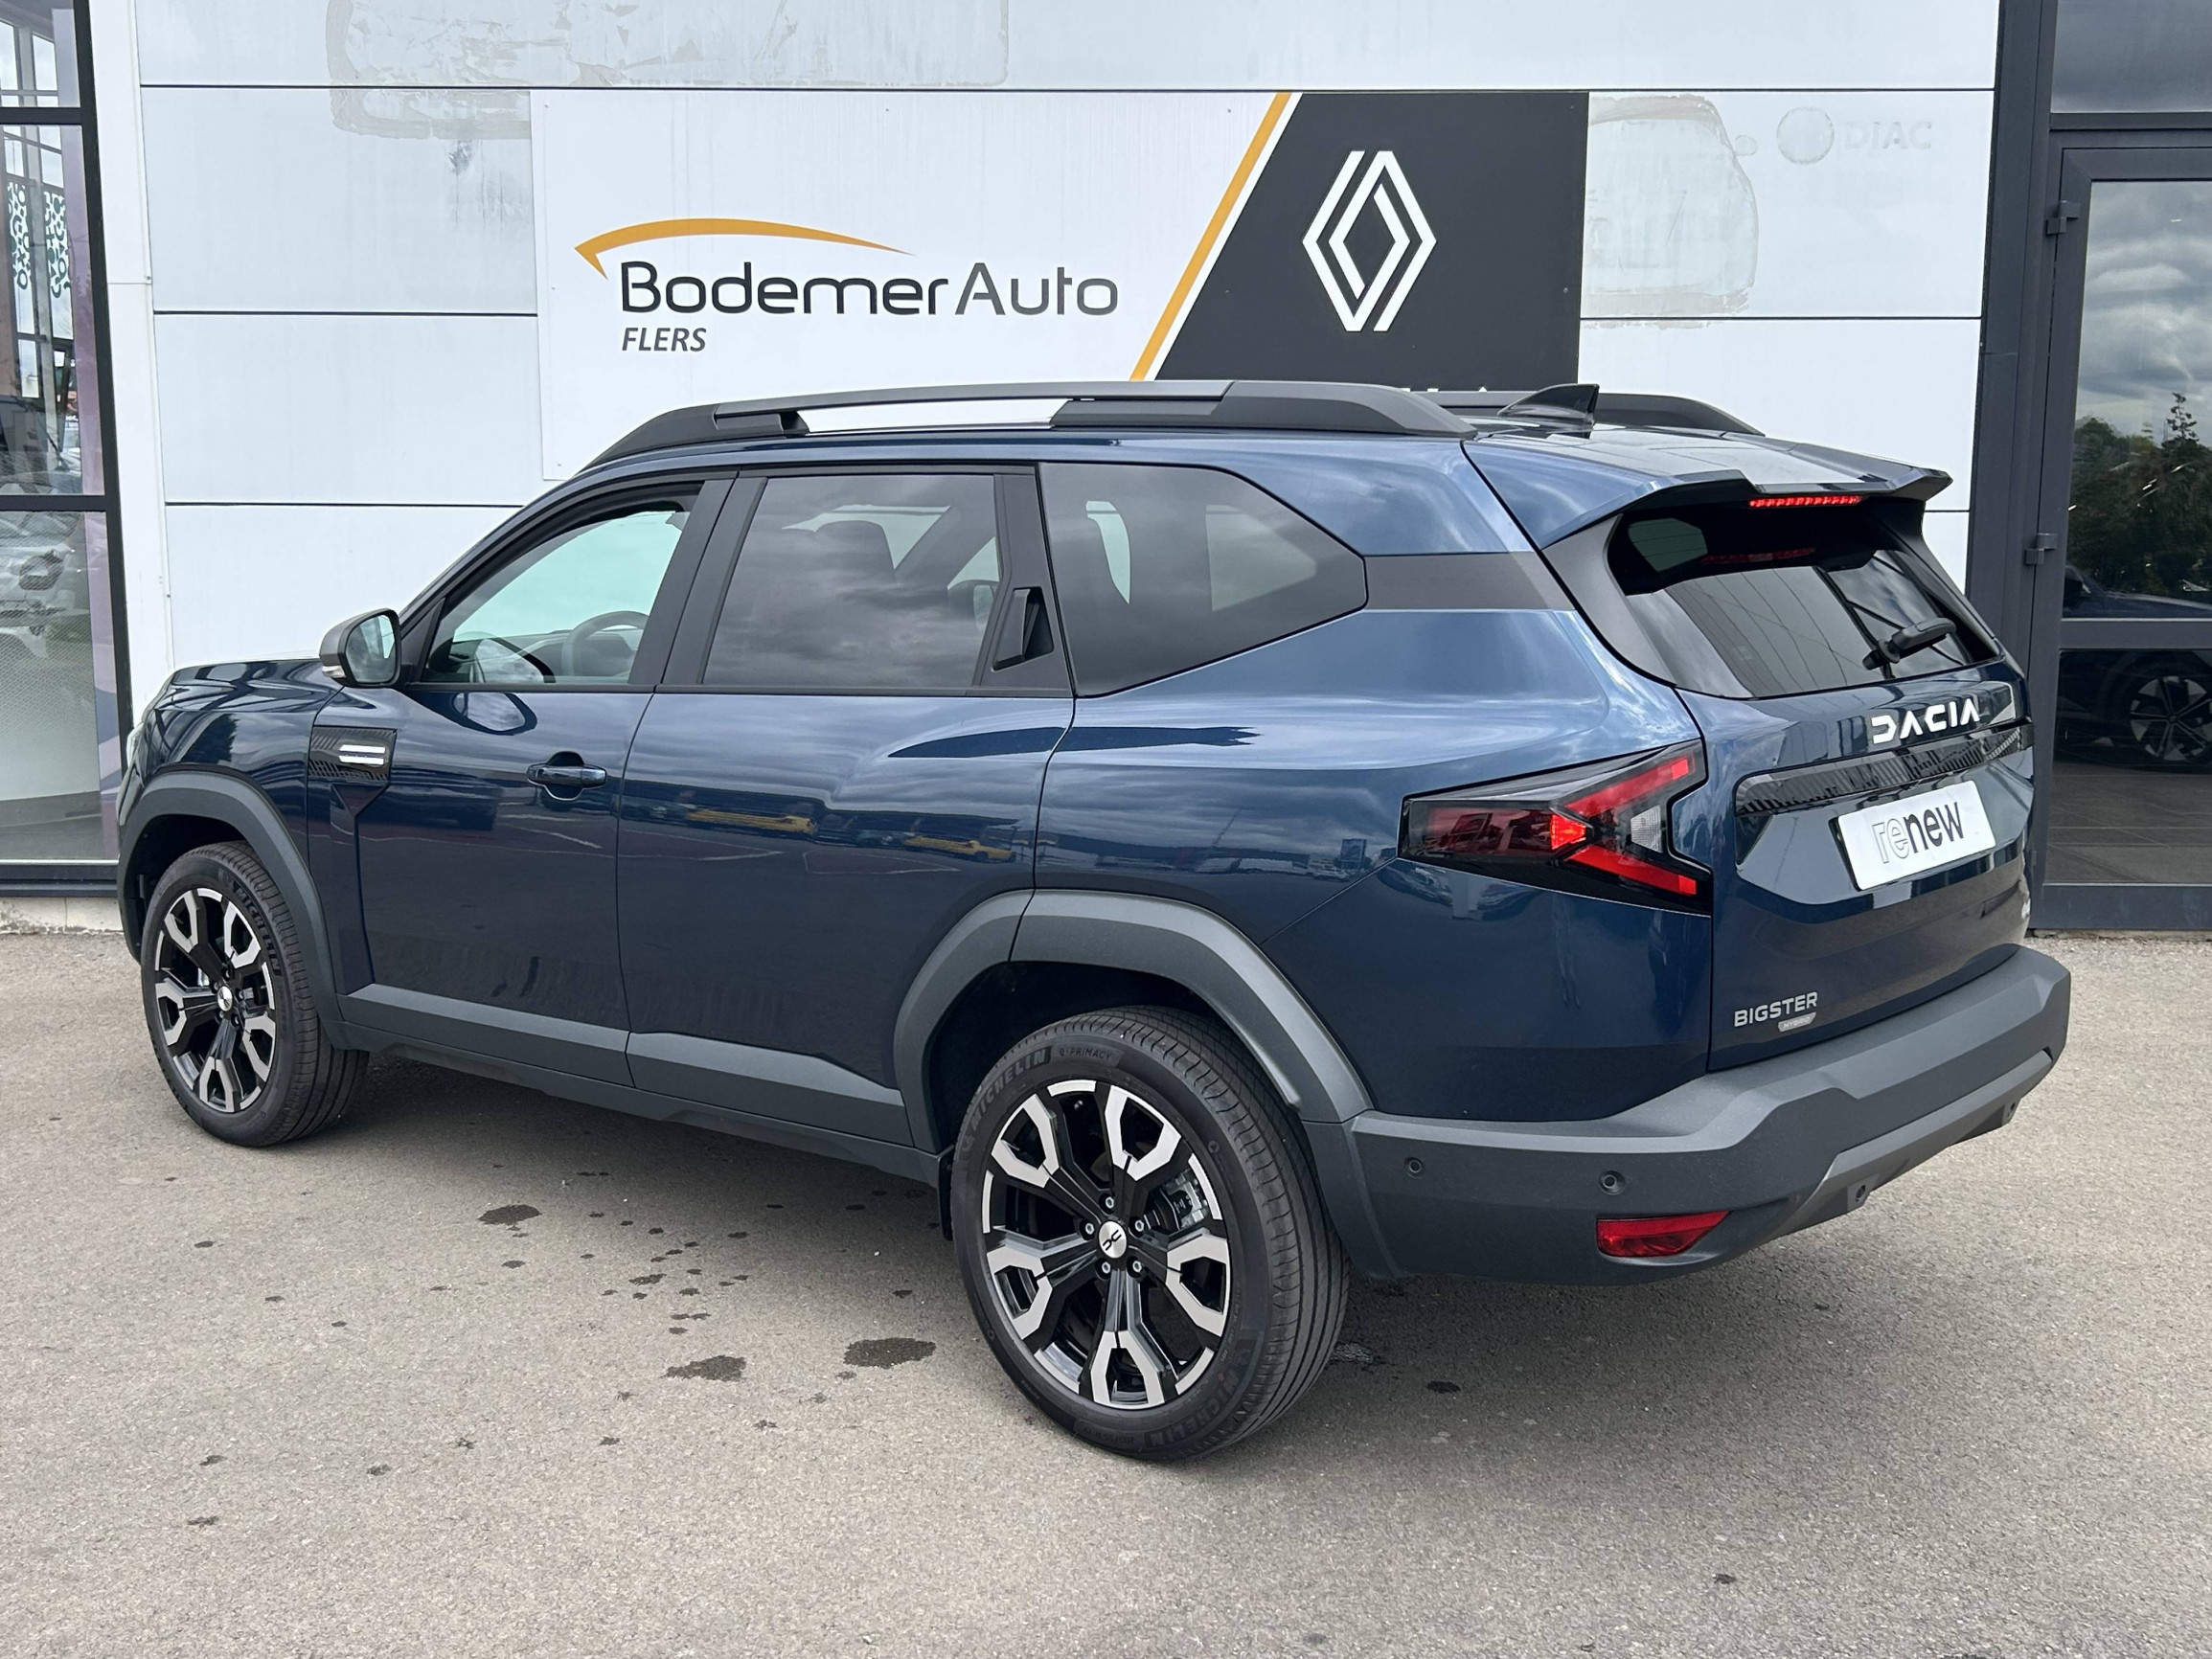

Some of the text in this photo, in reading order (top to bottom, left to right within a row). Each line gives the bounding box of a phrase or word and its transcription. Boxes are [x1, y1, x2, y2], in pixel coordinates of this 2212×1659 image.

[621, 261, 1119, 315] Bodemer Auto
[621, 327, 707, 352] FLERS
[1871, 698, 1980, 744] DACIA
[1872, 802, 1964, 864] renew
[1734, 991, 1818, 1027] BIGSTER
[970, 1048, 1047, 1131] MICHELIN
